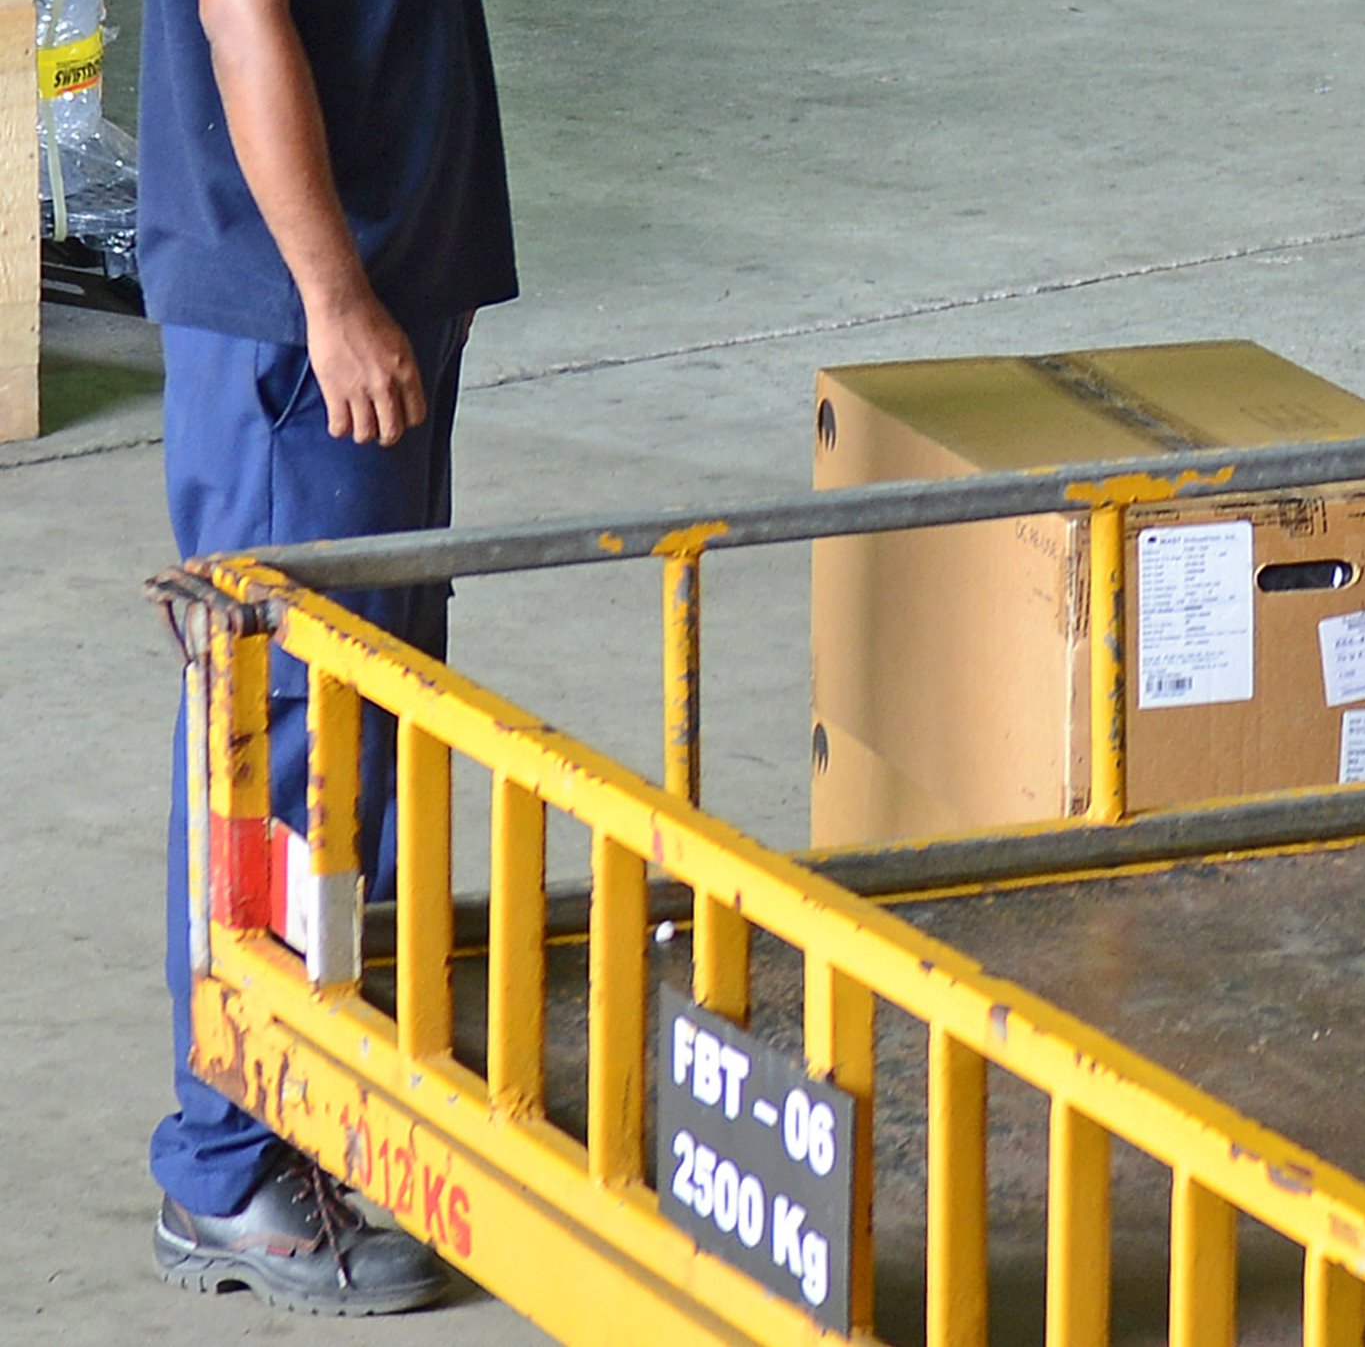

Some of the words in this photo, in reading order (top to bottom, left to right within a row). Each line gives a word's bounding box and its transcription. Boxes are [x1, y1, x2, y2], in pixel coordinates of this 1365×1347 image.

[671, 1014, 750, 1121] FBT
[782, 1087, 836, 1177] 06
[670, 1129, 765, 1248] 2500
[771, 1193, 829, 1307] Kg
